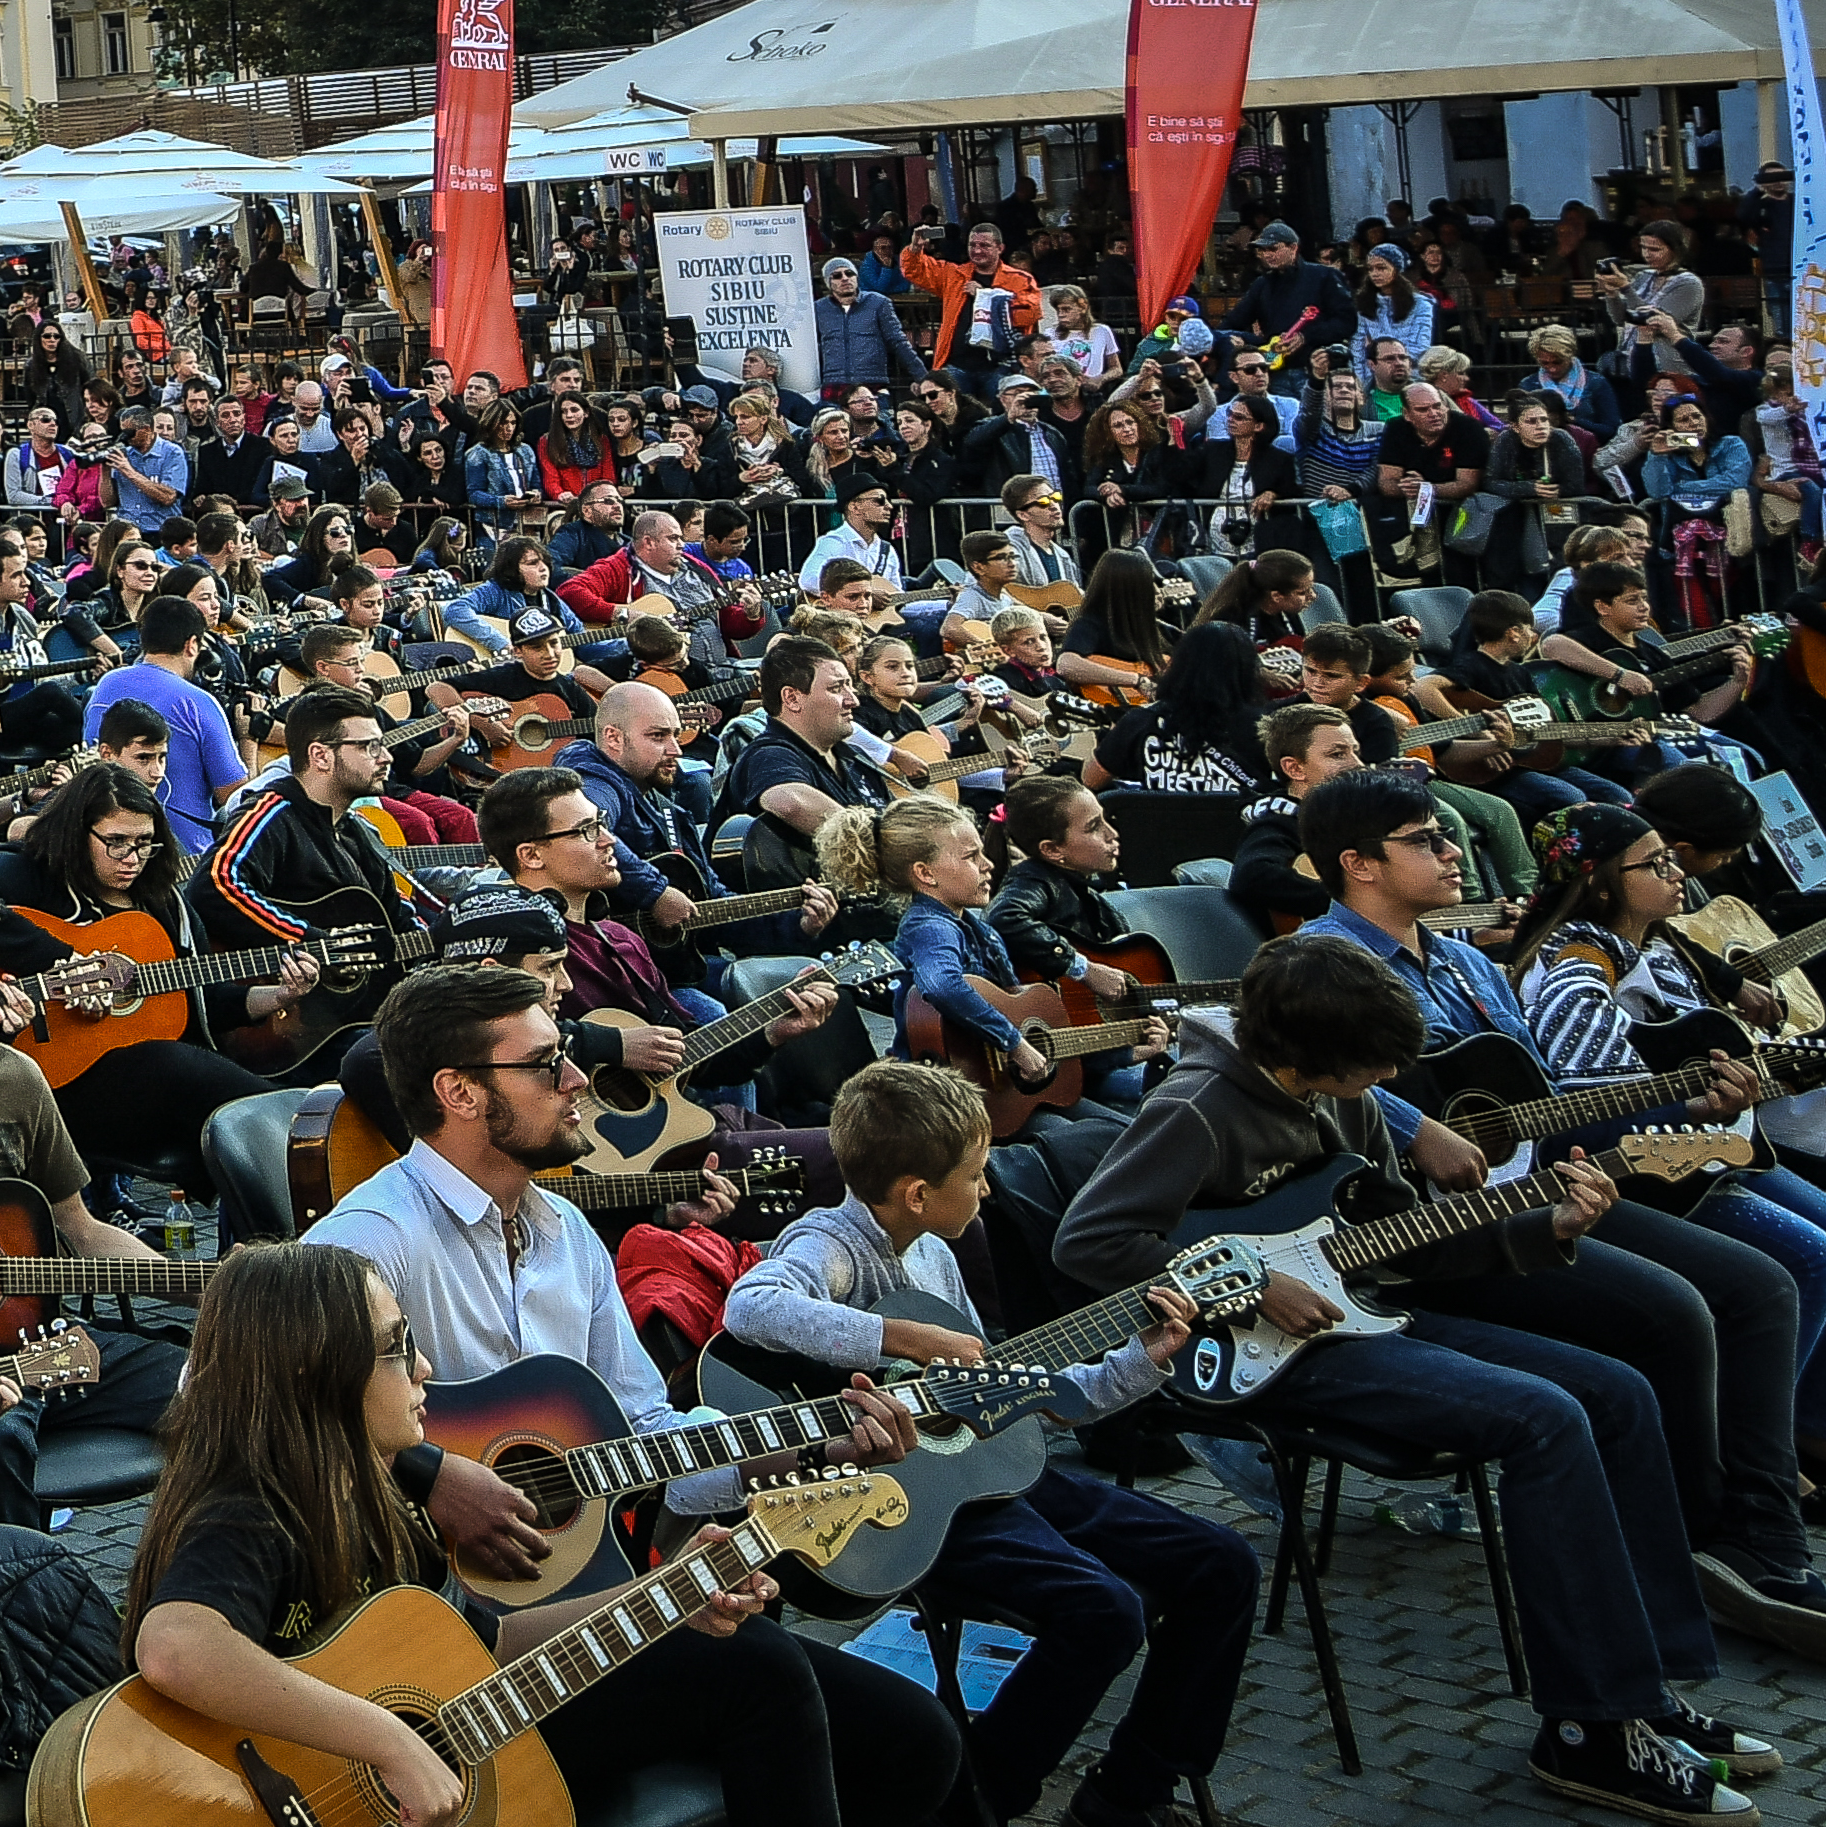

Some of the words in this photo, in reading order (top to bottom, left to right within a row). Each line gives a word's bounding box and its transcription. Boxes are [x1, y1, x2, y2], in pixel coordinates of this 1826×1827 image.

[1147, 115, 1156, 127] E
[609, 153, 641, 169] WC
[647, 151, 664, 167] WC
[662, 223, 702, 237] Rotary
[735, 217, 769, 228] ROTARY
[771, 216, 797, 226] CLUB
[678, 256, 745, 279] ROTARY
[748, 254, 794, 275] CLUB
[711, 280, 765, 302] SIBIU
[1206, 747, 1220, 761] pe
[1219, 757, 1257, 790] Chitară
[1145, 769, 1241, 793] MEETING
